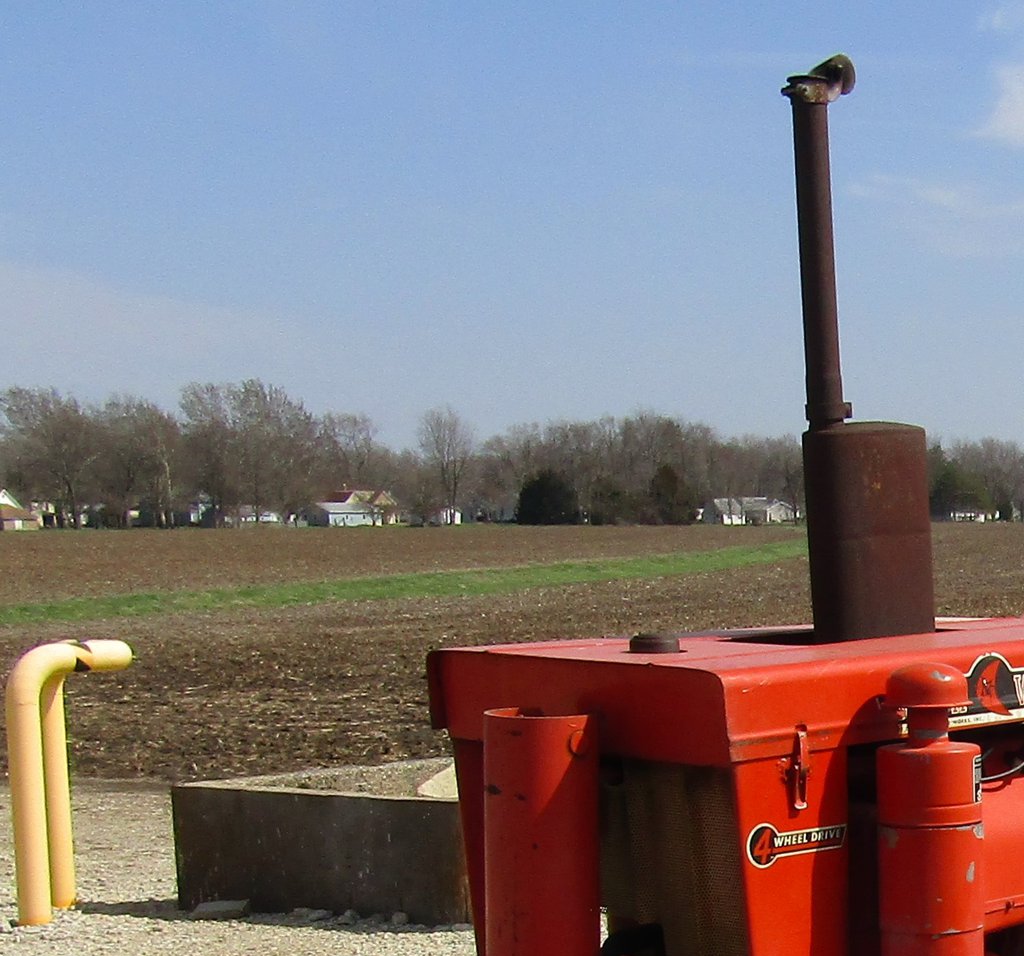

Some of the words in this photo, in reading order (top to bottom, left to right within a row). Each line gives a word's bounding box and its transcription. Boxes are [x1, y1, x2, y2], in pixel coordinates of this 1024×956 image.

[753, 828, 774, 864] 4
[773, 833, 808, 848] WHEEL
[811, 828, 841, 842] DRIVE
